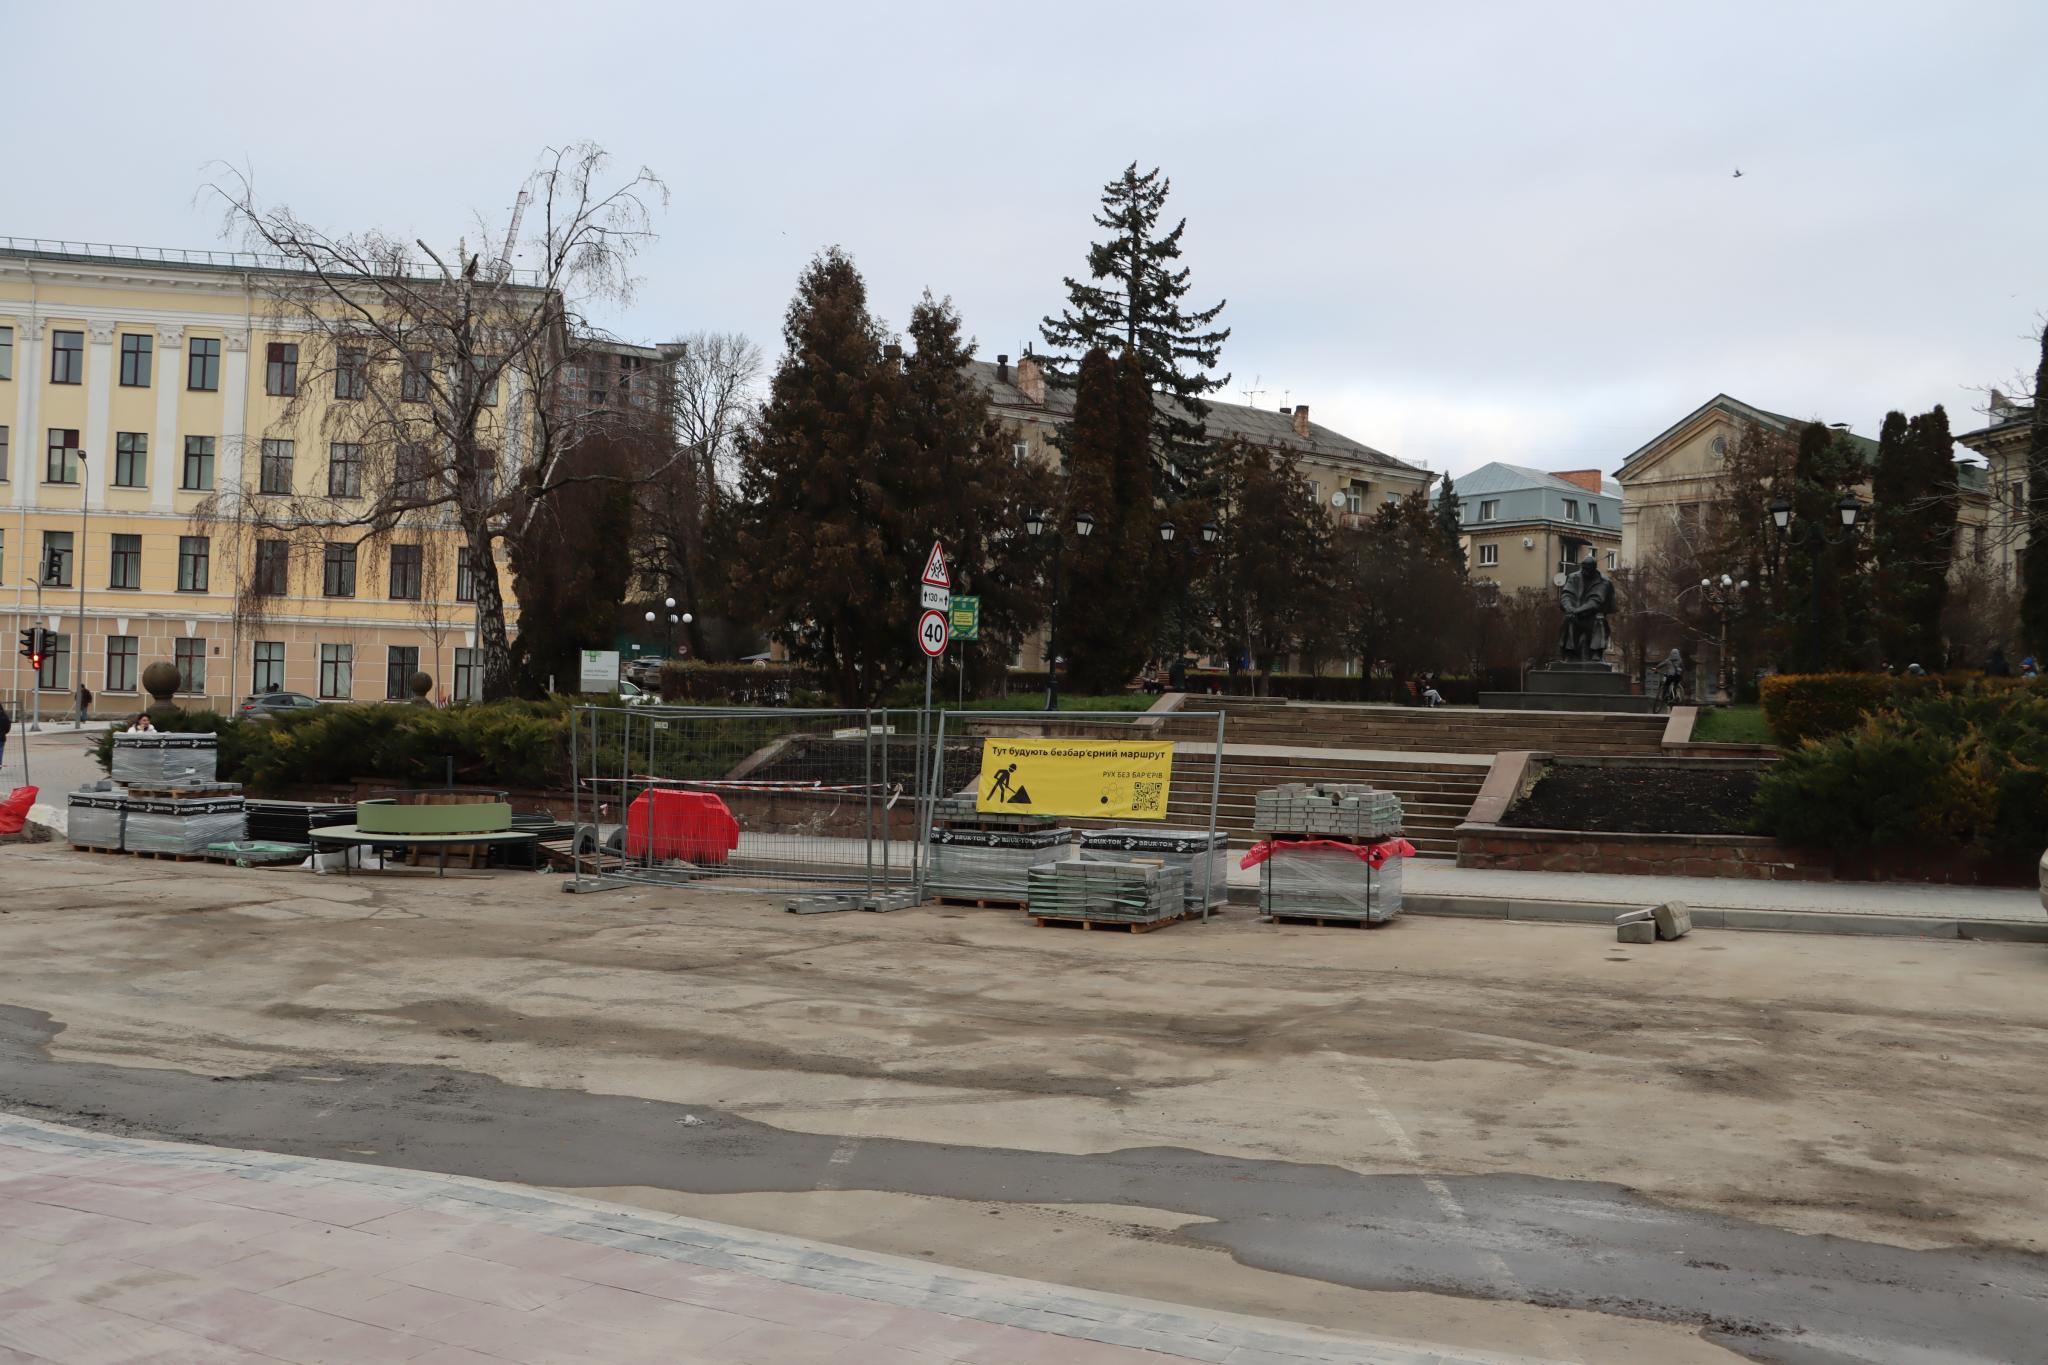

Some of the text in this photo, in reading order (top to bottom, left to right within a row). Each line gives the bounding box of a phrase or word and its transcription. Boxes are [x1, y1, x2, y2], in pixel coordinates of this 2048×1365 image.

[928, 592, 938, 602] 130
[924, 623, 943, 643] 40
[992, 746, 1165, 760] Тут будують безбар'єрний маршрут
